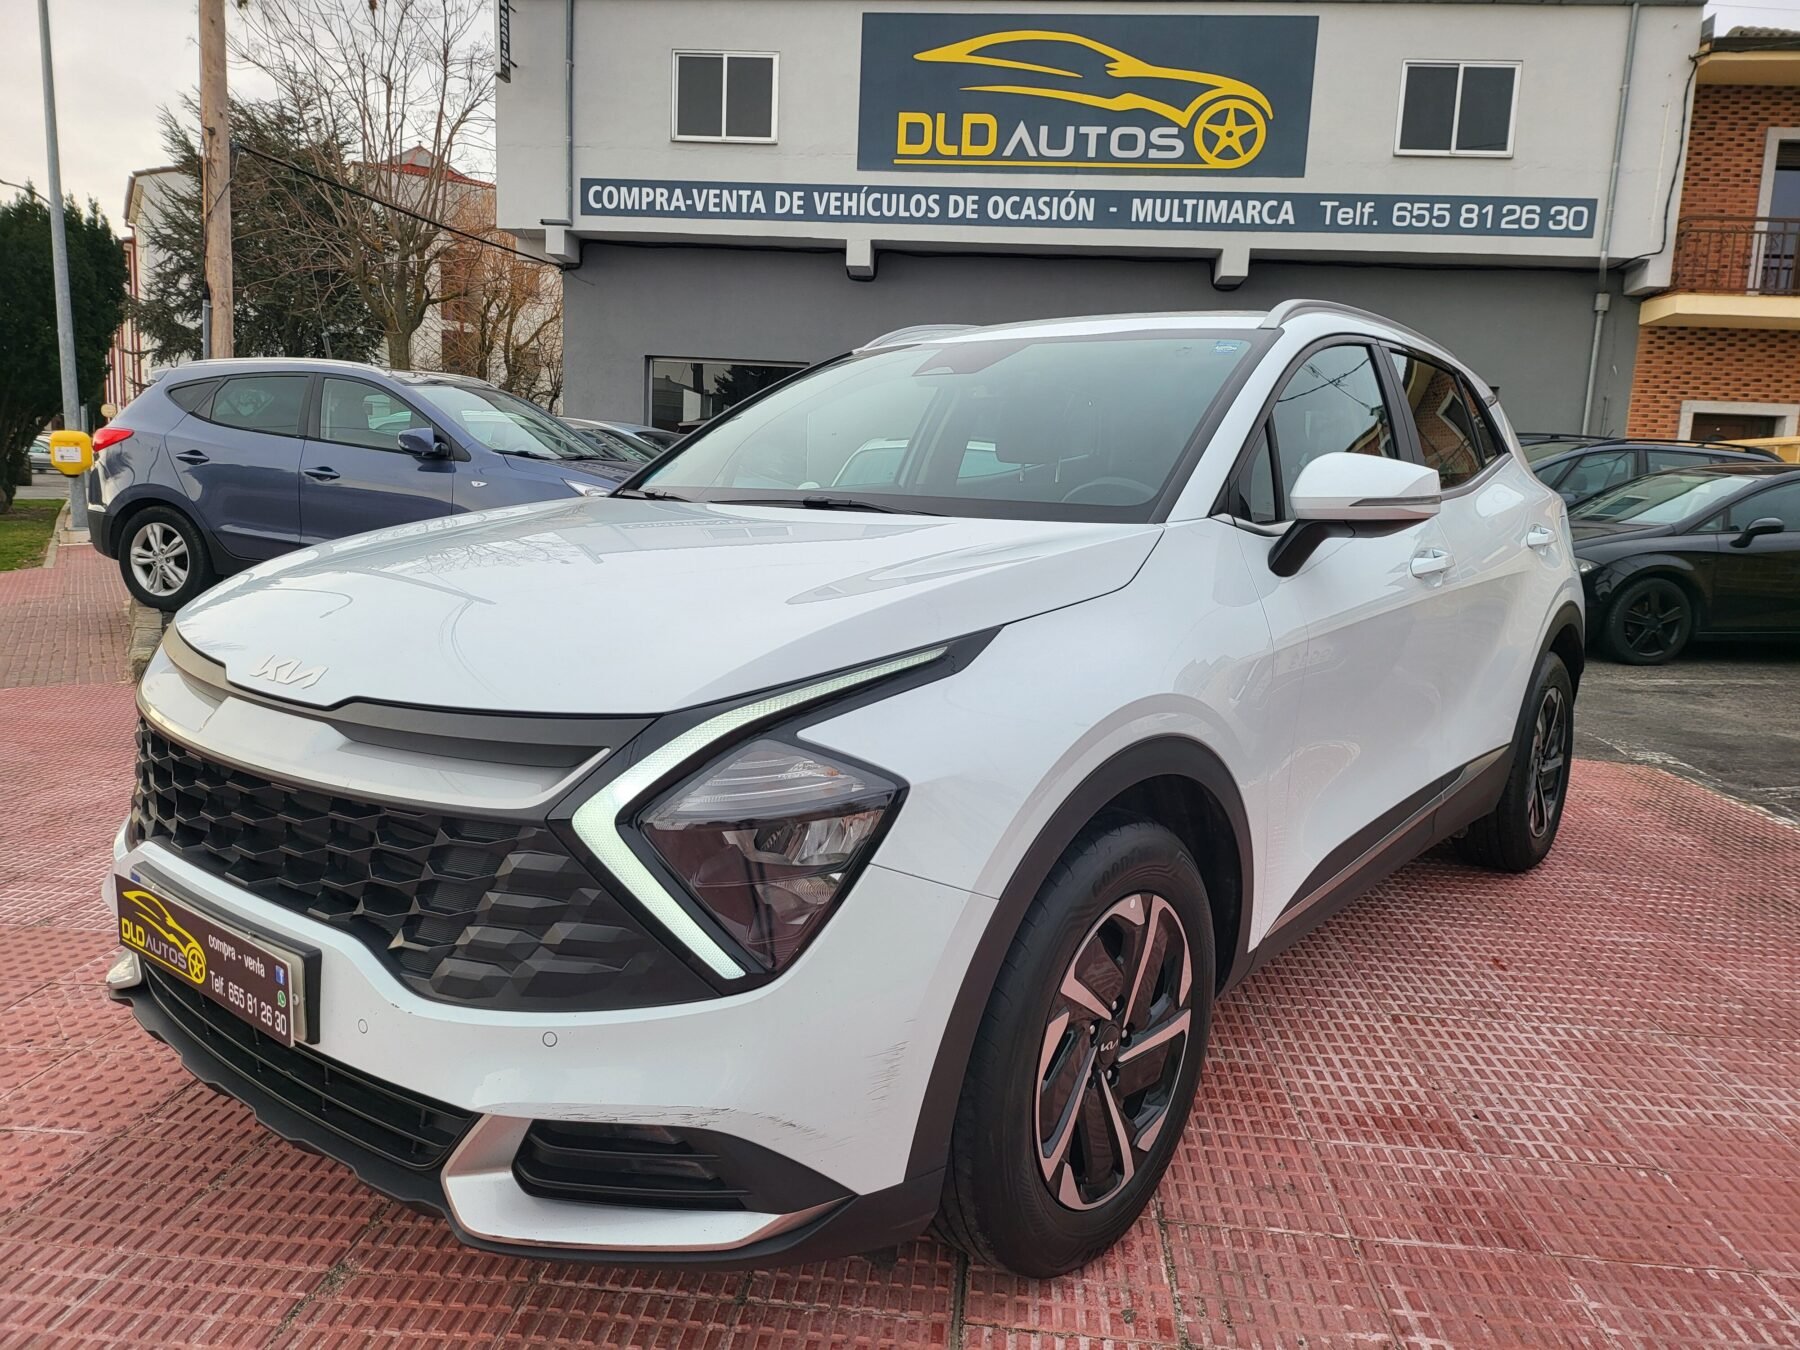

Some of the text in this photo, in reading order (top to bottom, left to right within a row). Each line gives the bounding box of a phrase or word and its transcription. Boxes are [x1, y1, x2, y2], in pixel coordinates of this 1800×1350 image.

[896, 111, 1185, 159] DLD AUTOS
[588, 185, 766, 214] COMPRA-VENTA
[775, 191, 804, 215] DE
[813, 187, 940, 218] VEHÍCULOS
[948, 194, 979, 219] DE
[987, 190, 1095, 222] OCASIÓN
[1131, 198, 1295, 225] MULTIMARCA
[1319, 201, 1589, 231] Telf. 655 81 26 30
[249, 653, 330, 690] KIA
[121, 917, 187, 970] DLD AUTOS
[208, 934, 236, 961] compra
[243, 954, 265, 978] venta
[209, 970, 287, 1036] Telf. 655 81 26 30
